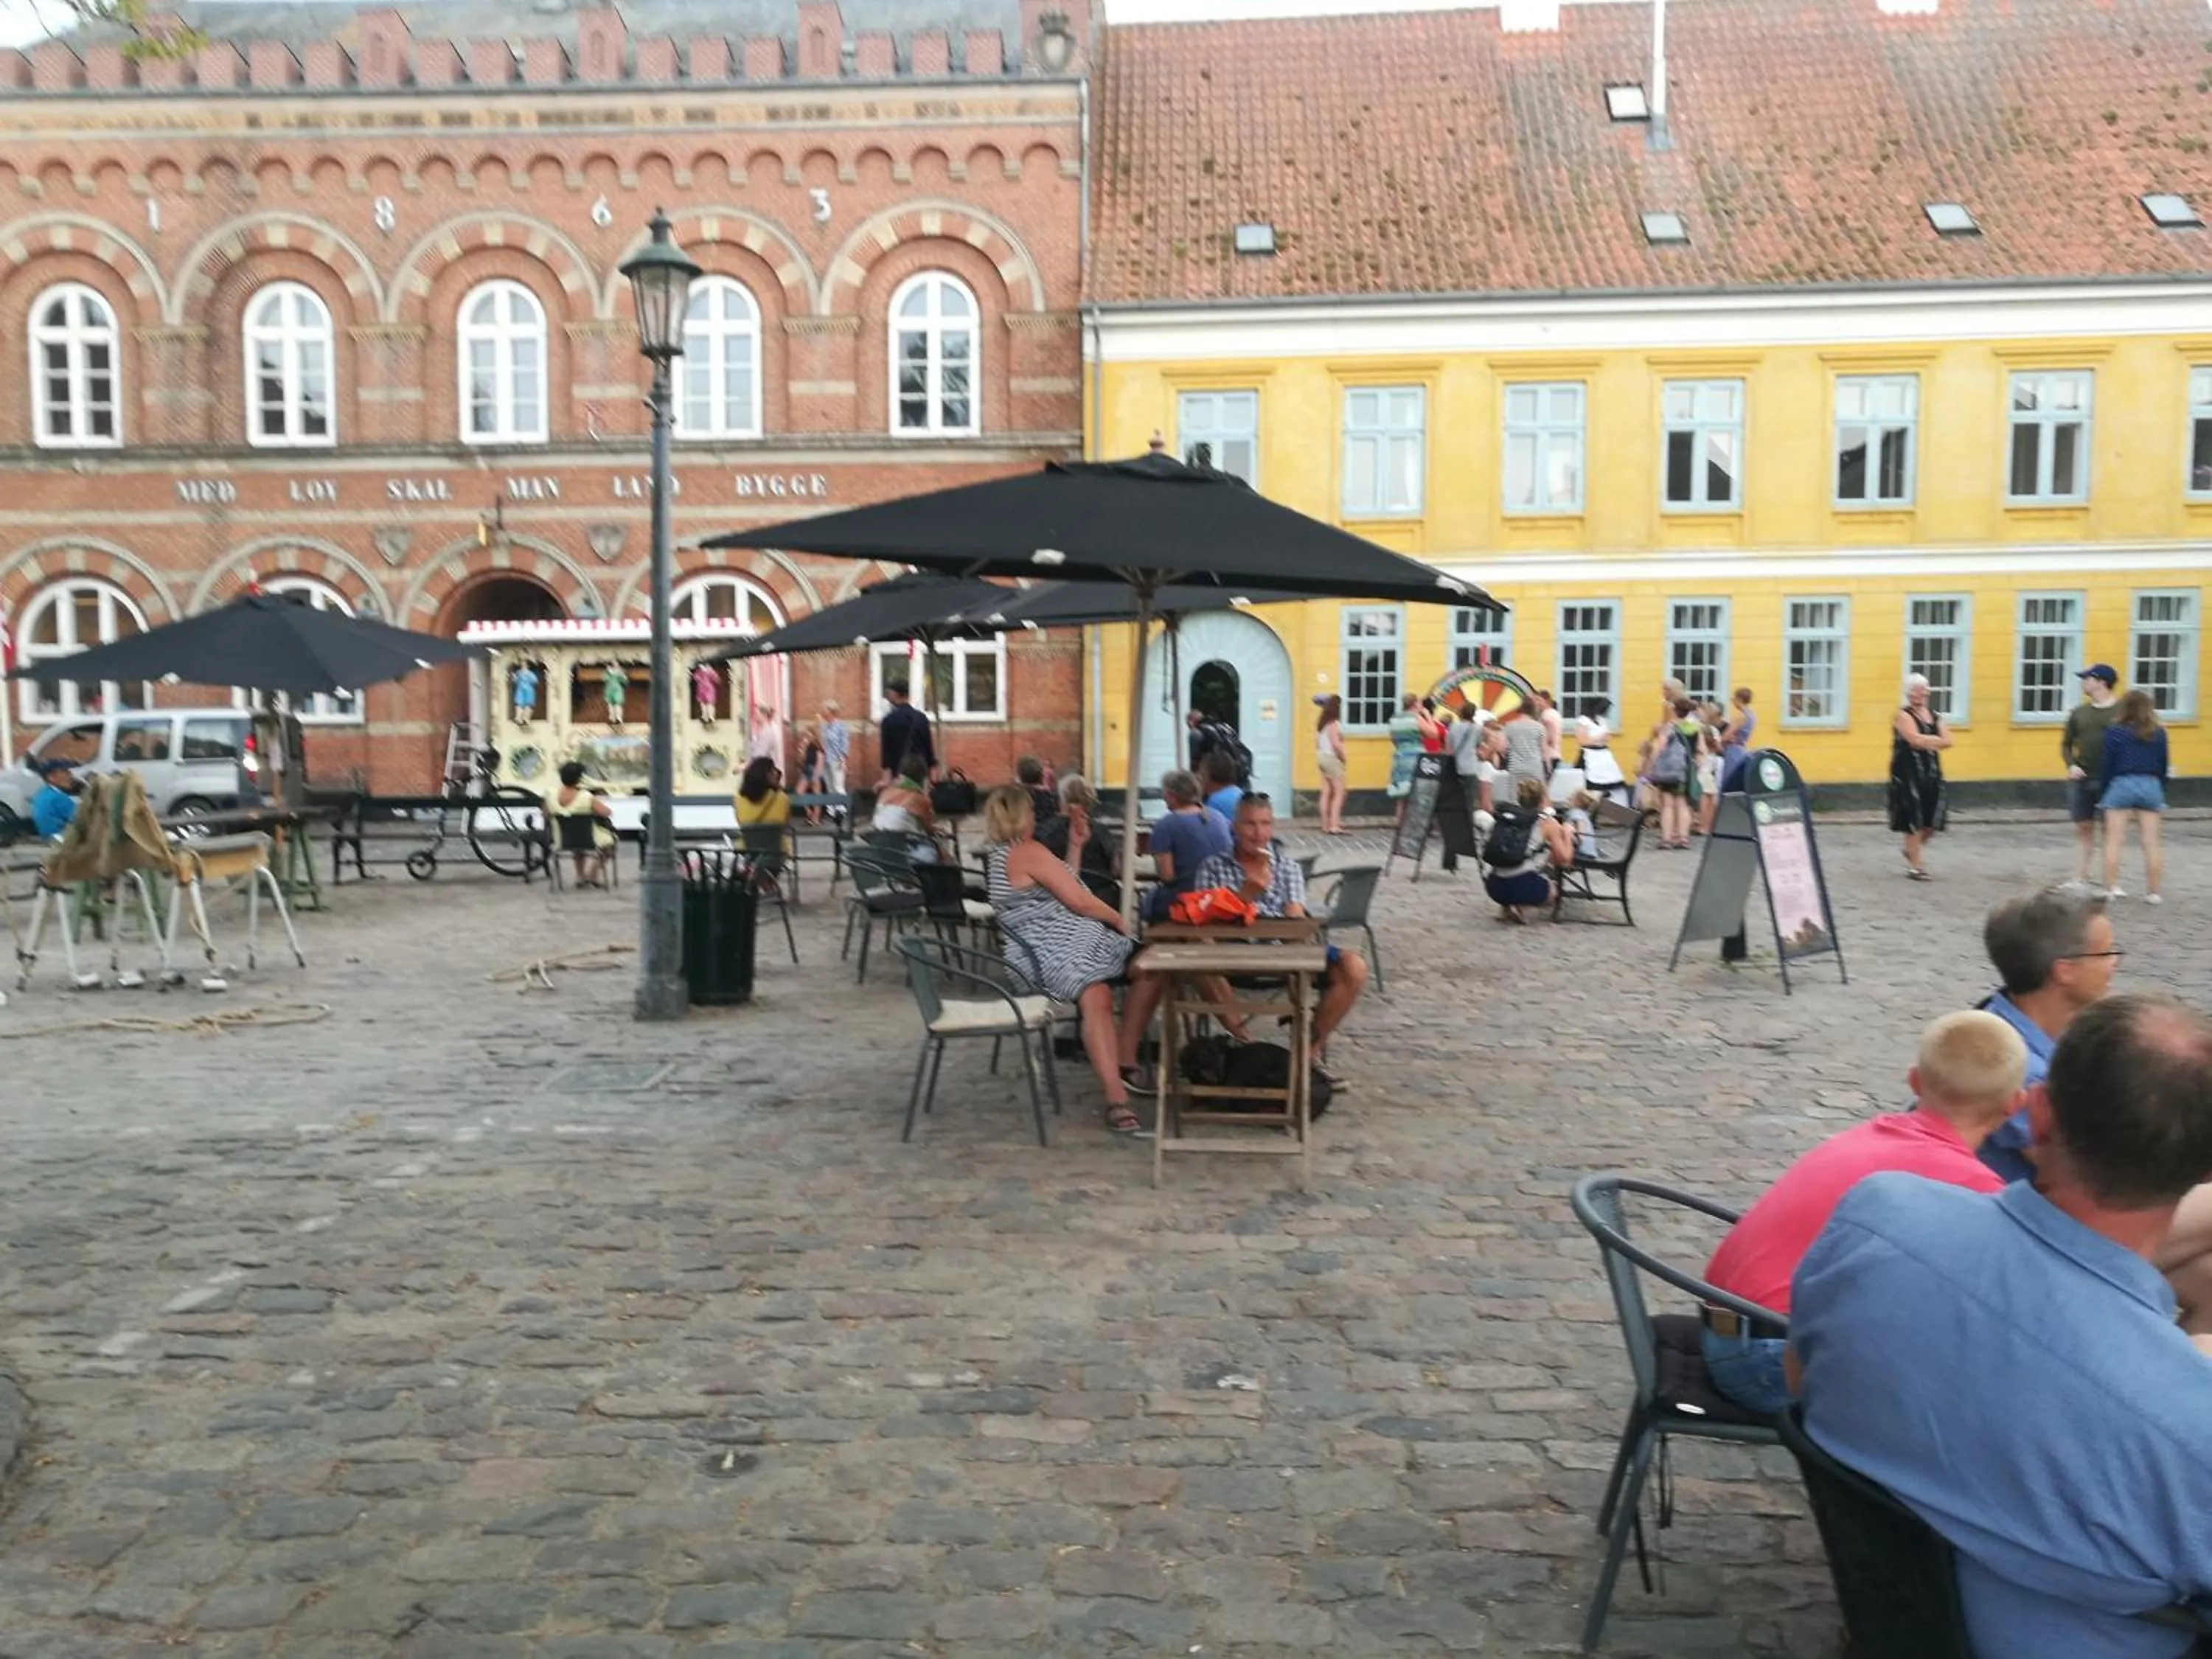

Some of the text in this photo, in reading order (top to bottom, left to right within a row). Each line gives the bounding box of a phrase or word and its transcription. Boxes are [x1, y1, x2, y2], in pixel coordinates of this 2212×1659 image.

[375, 195, 396, 232] 8
[591, 192, 613, 226] 6
[175, 480, 237, 503] MED
[387, 479, 453, 501] SKAL
[507, 476, 560, 498] MAN
[736, 474, 827, 496] BYGGE
